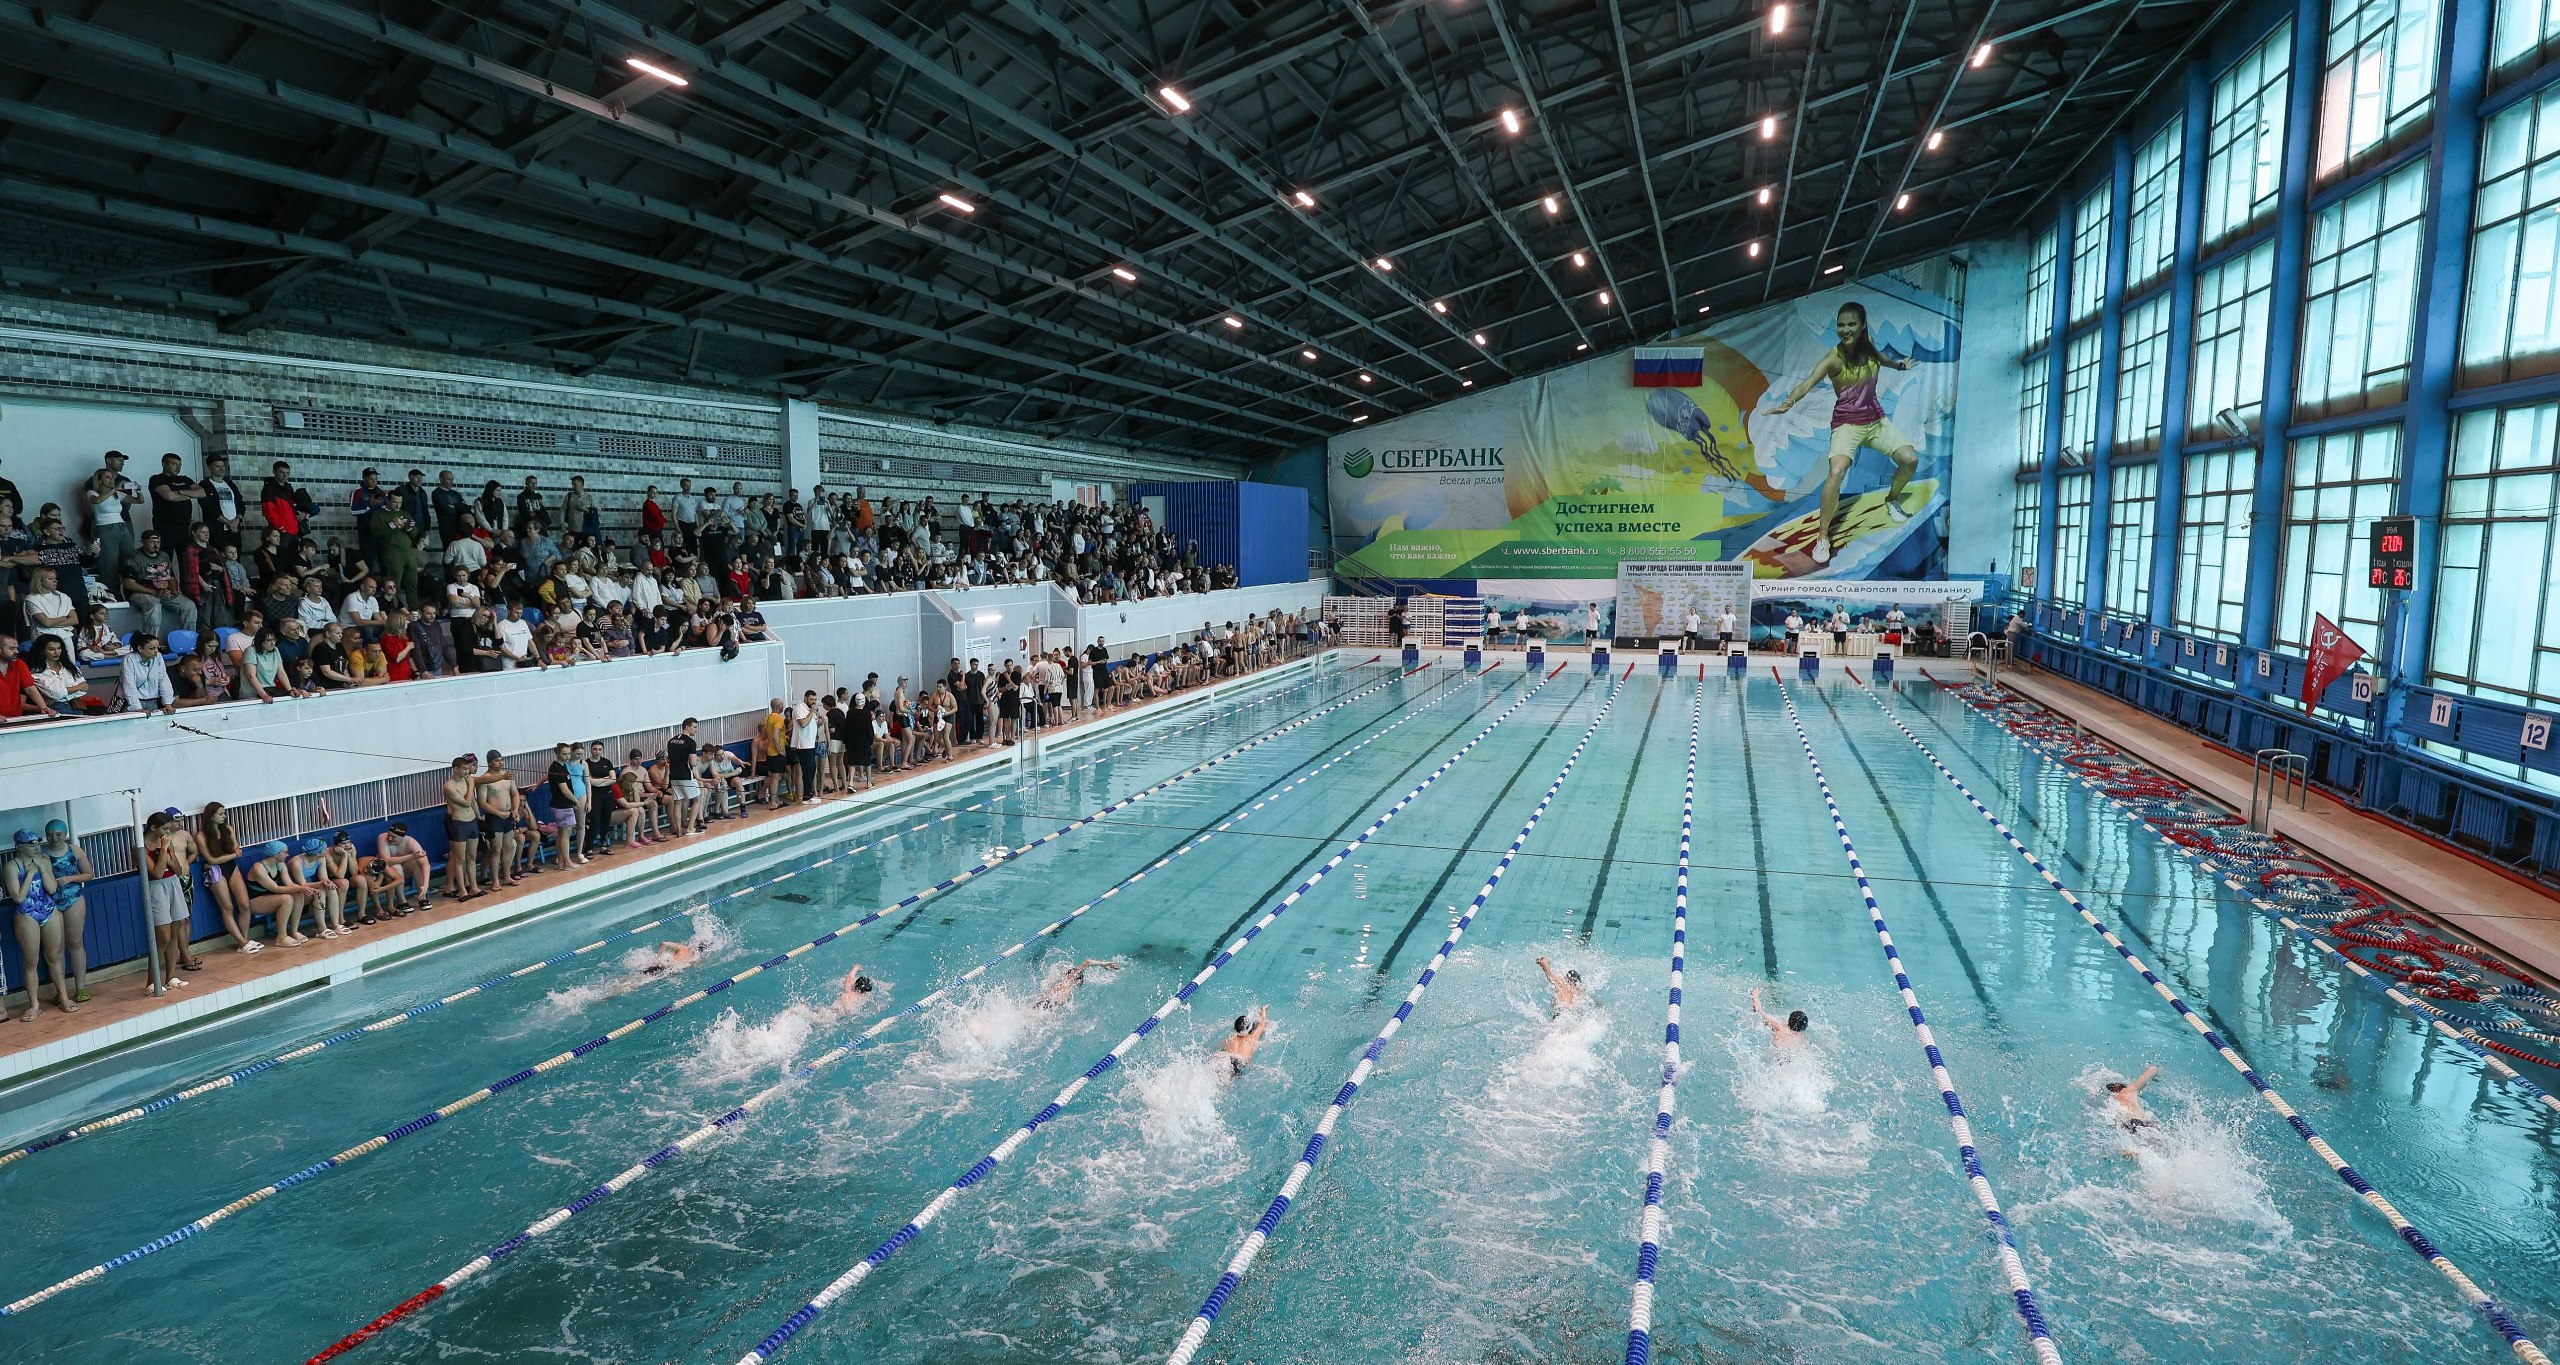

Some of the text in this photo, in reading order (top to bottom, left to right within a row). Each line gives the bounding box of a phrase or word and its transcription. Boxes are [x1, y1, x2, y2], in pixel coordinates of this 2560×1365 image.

[1382, 448, 1504, 468] СБЕРБАНК
[1440, 476, 1504, 486] Всегда рядом
[1556, 502, 1654, 516] Достигнем
[1555, 522, 1681, 536] успеха вместе
[1513, 546, 1598, 555] www.sberbank.ru
[1620, 547, 1696, 556] 8 800 555 55 50
[1634, 639, 1639, 647] 2
[2153, 633, 2157, 644] 5
[2187, 642, 2192, 653] 6
[2219, 651, 2224, 662] 7
[2262, 660, 2266, 673] 8
[2355, 682, 2369, 698] 10
[2437, 704, 2446, 722] 11
[2528, 724, 2545, 745] 12
